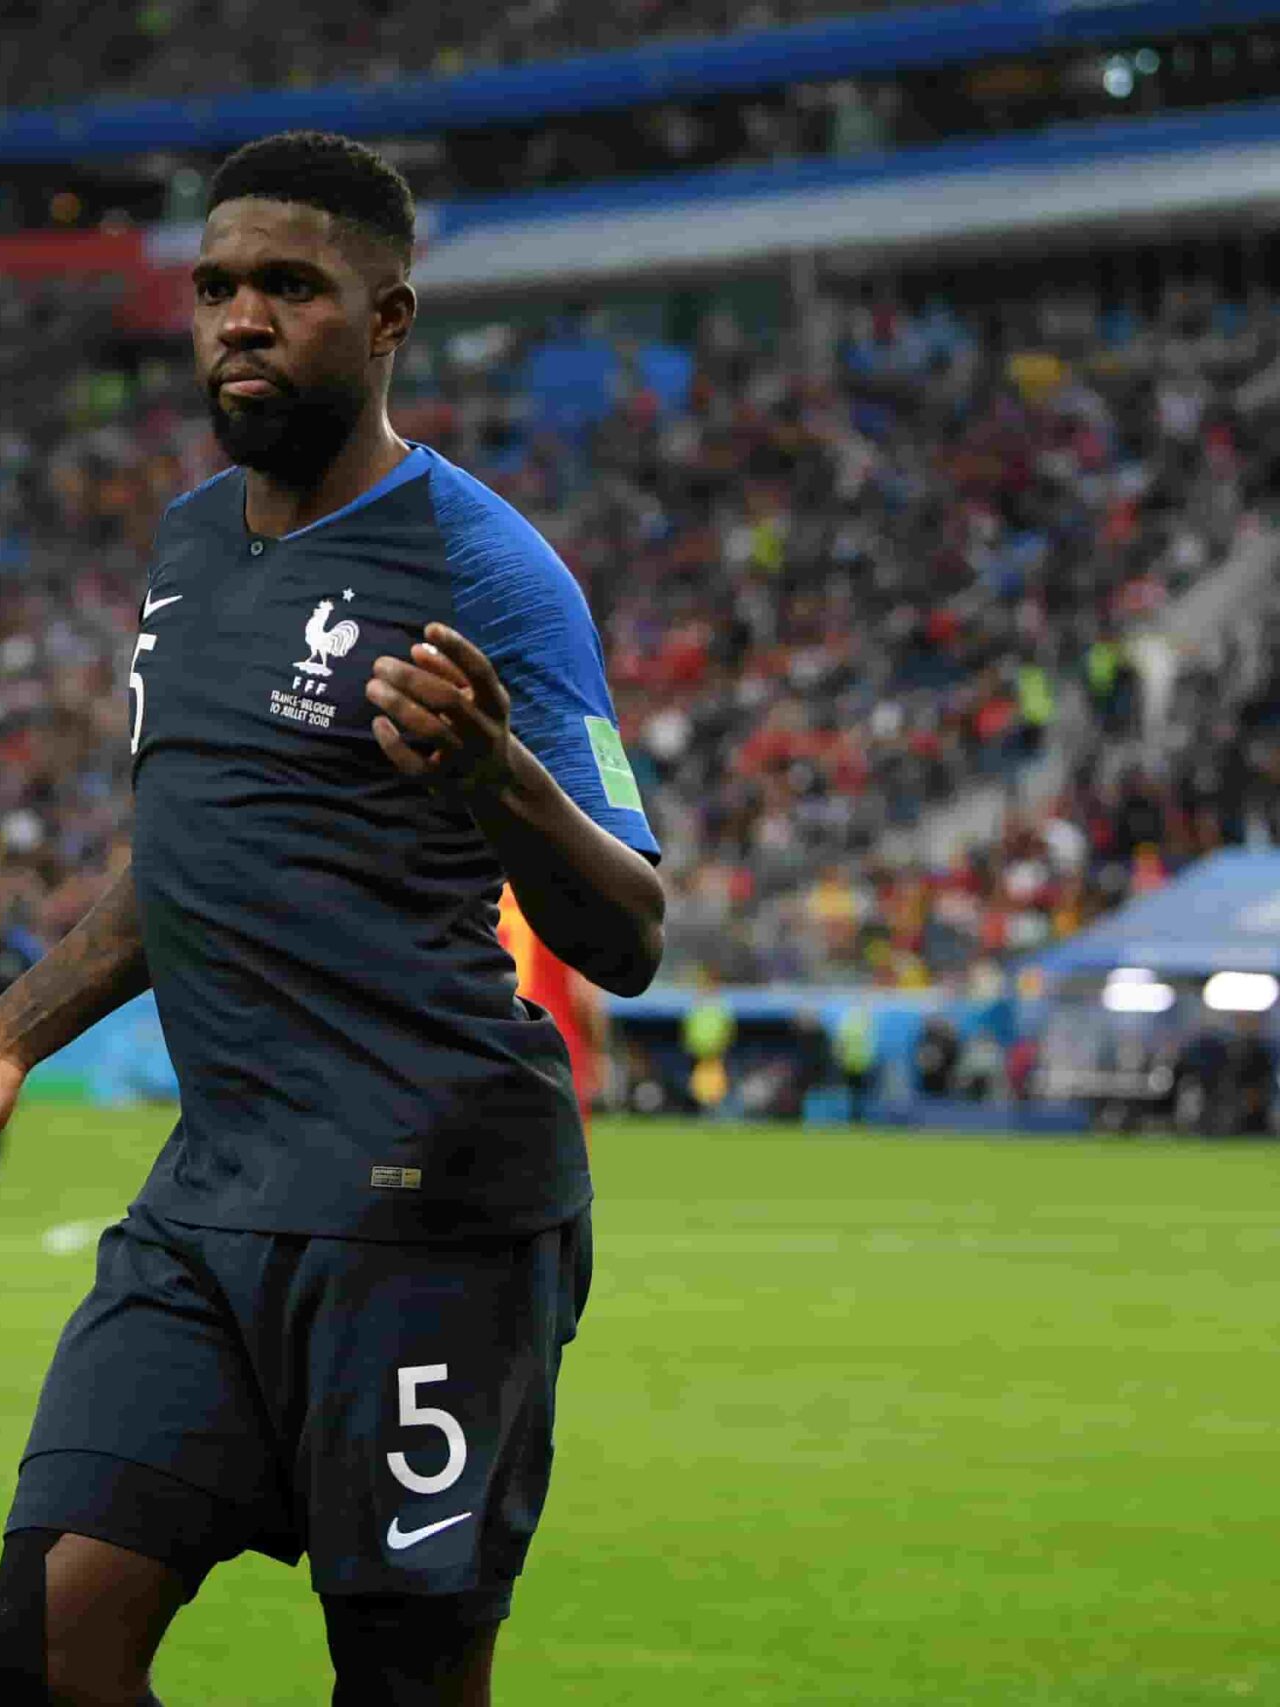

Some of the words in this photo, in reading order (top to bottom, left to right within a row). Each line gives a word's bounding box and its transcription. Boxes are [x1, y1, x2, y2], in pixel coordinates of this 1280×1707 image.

[269, 702, 280, 714] 10
[280, 704, 308, 721] JUILLET
[308, 712, 331, 728] 2018
[386, 1363, 467, 1494] 5
